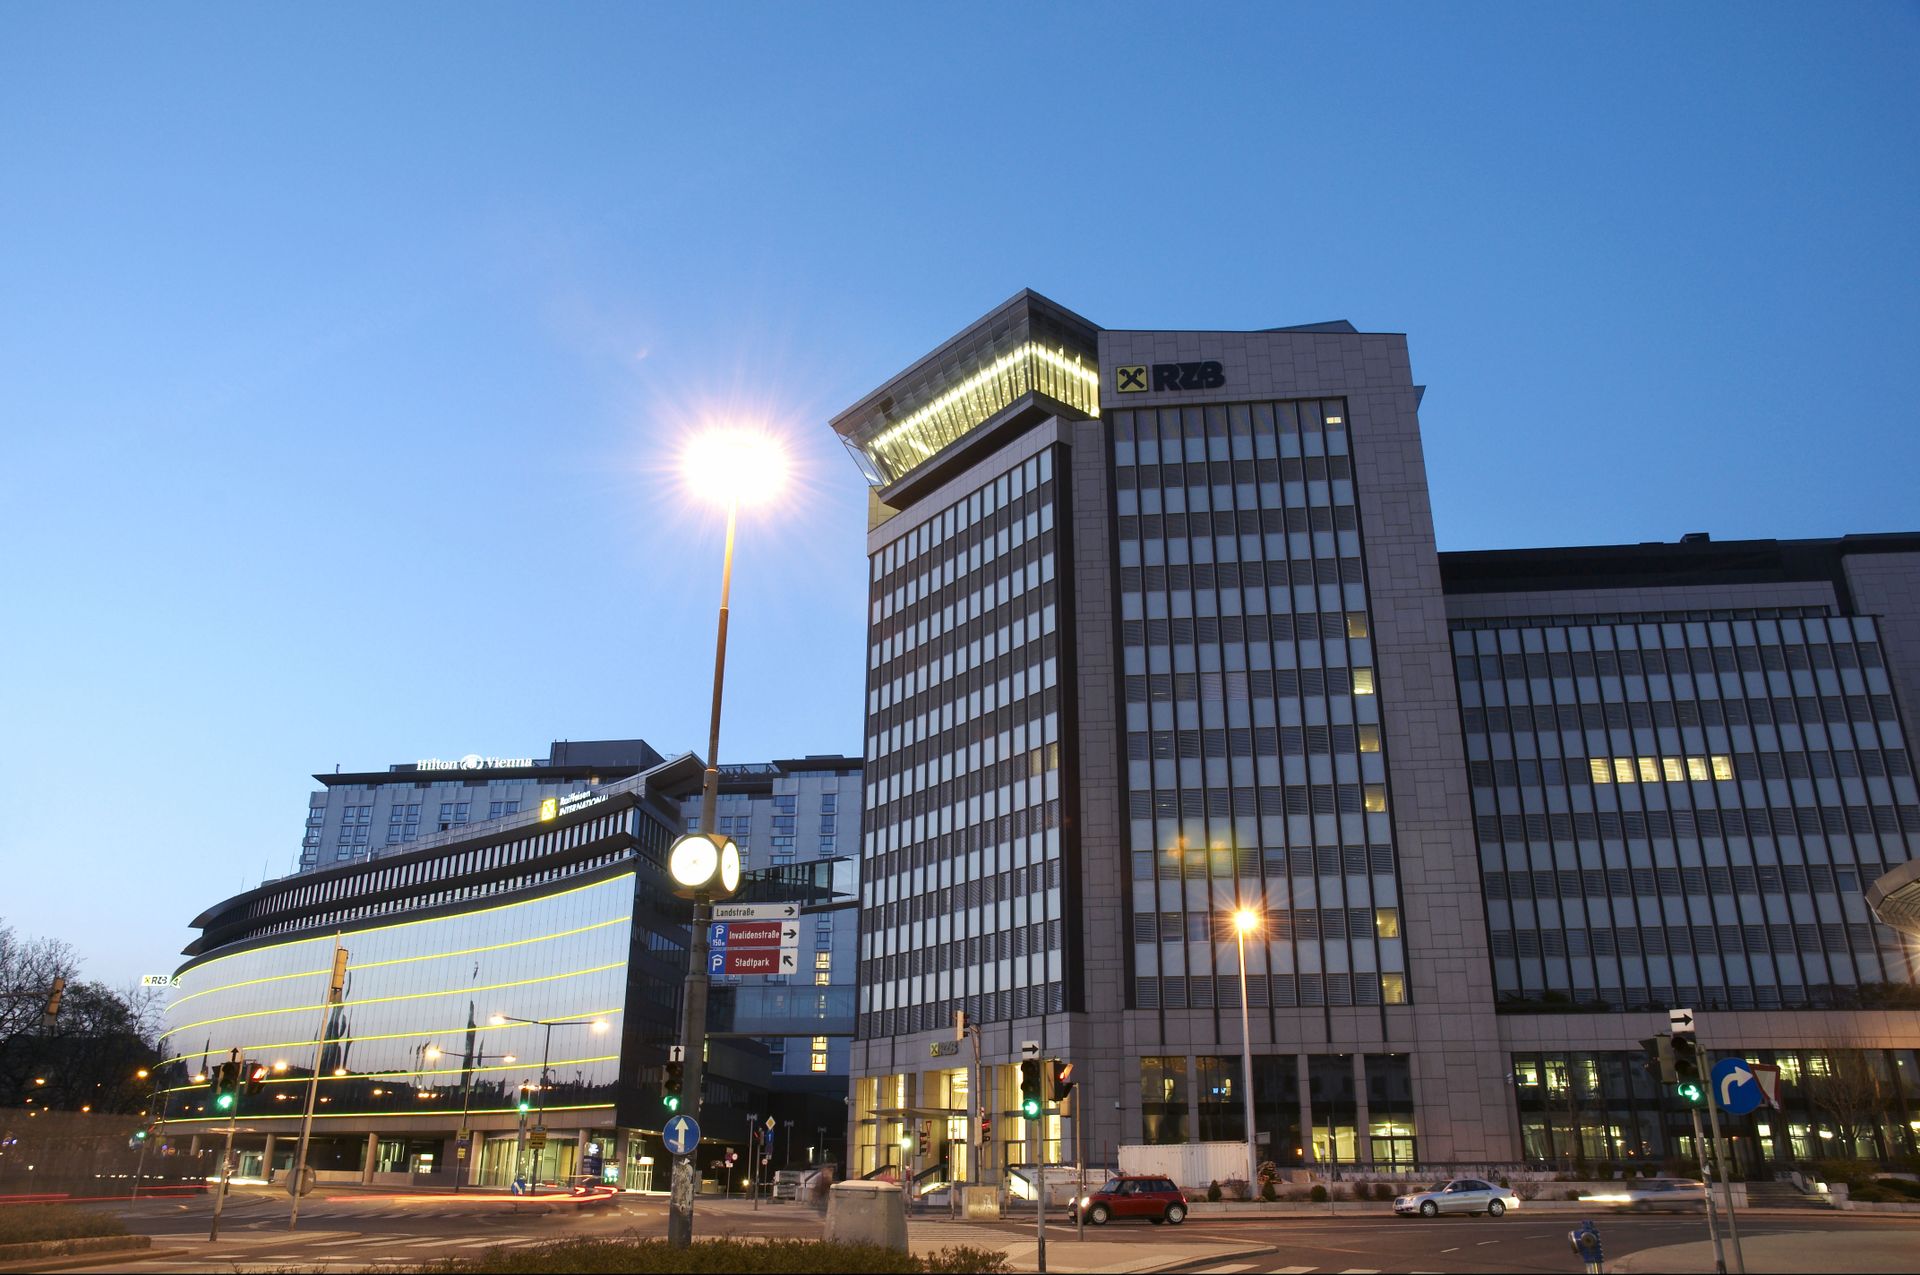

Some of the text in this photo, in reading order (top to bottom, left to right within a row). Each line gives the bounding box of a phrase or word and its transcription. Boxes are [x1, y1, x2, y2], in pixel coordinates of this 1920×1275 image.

[1152, 361, 1226, 392] RZB
[416, 756, 533, 771] Hilton Vienna
[716, 908, 755, 917] Landstraße
[729, 930, 780, 940] Invalidenstraße
[735, 958, 770, 969] Stadtpark
